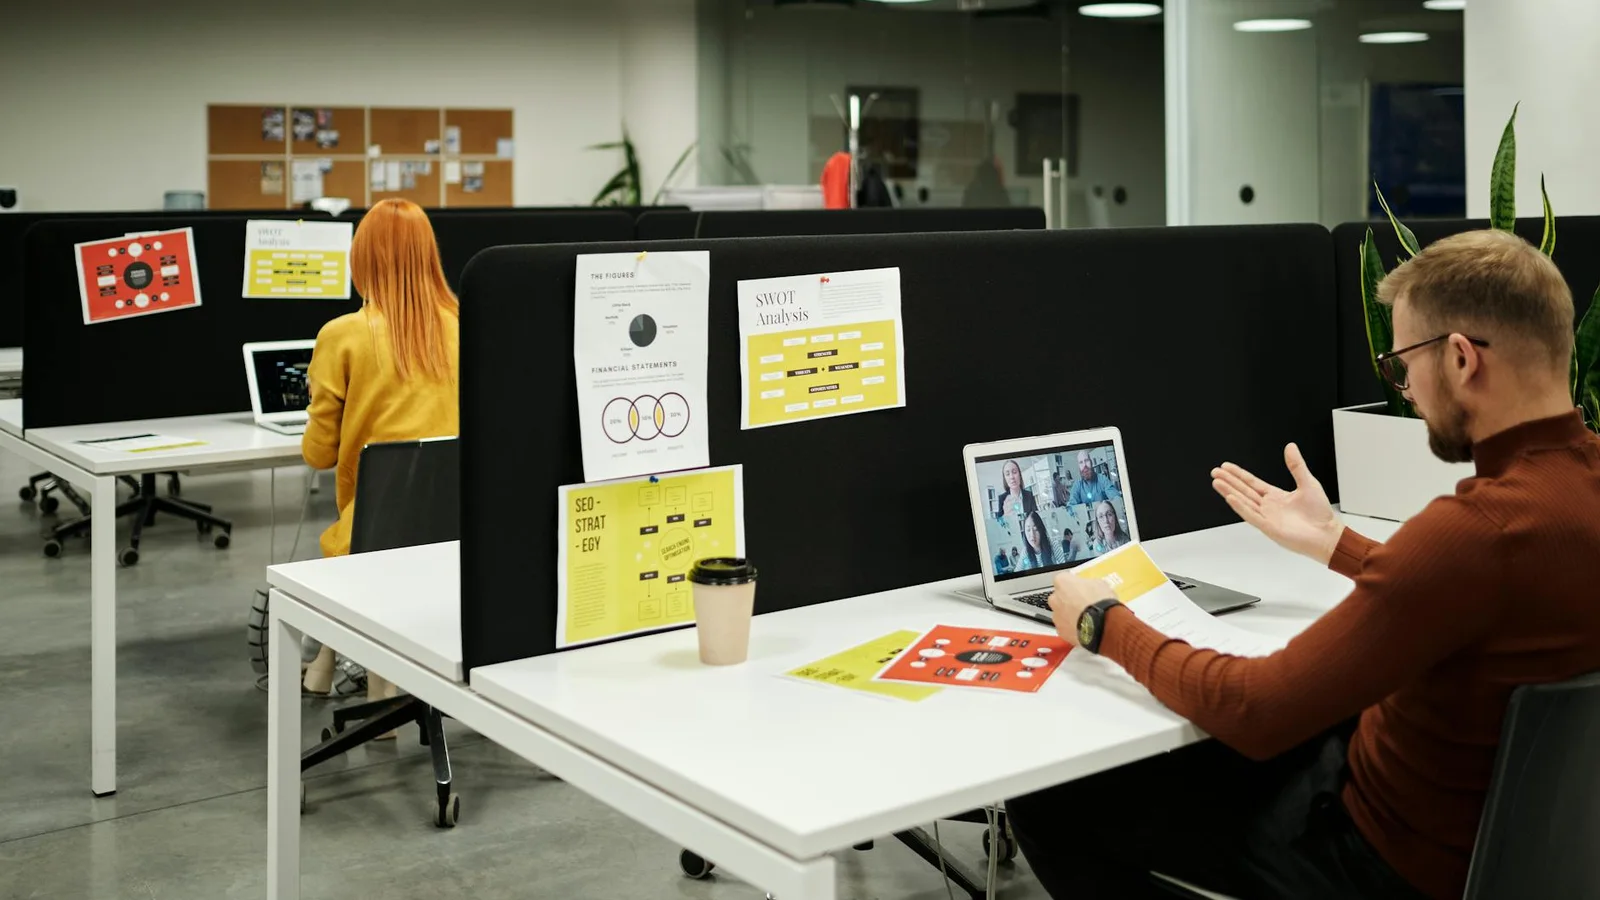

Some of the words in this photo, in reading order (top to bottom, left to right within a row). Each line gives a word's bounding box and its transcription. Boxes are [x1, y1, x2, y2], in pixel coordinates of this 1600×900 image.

[605, 271, 634, 279] FIGURES
[756, 290, 796, 308] SWOT
[756, 307, 809, 326] Analysis
[591, 365, 629, 374] FINANCIAL
[632, 361, 677, 371] STATEMENTS
[575, 496, 594, 513] SEO
[575, 515, 606, 533] STRAT
[582, 536, 601, 552] EGY
